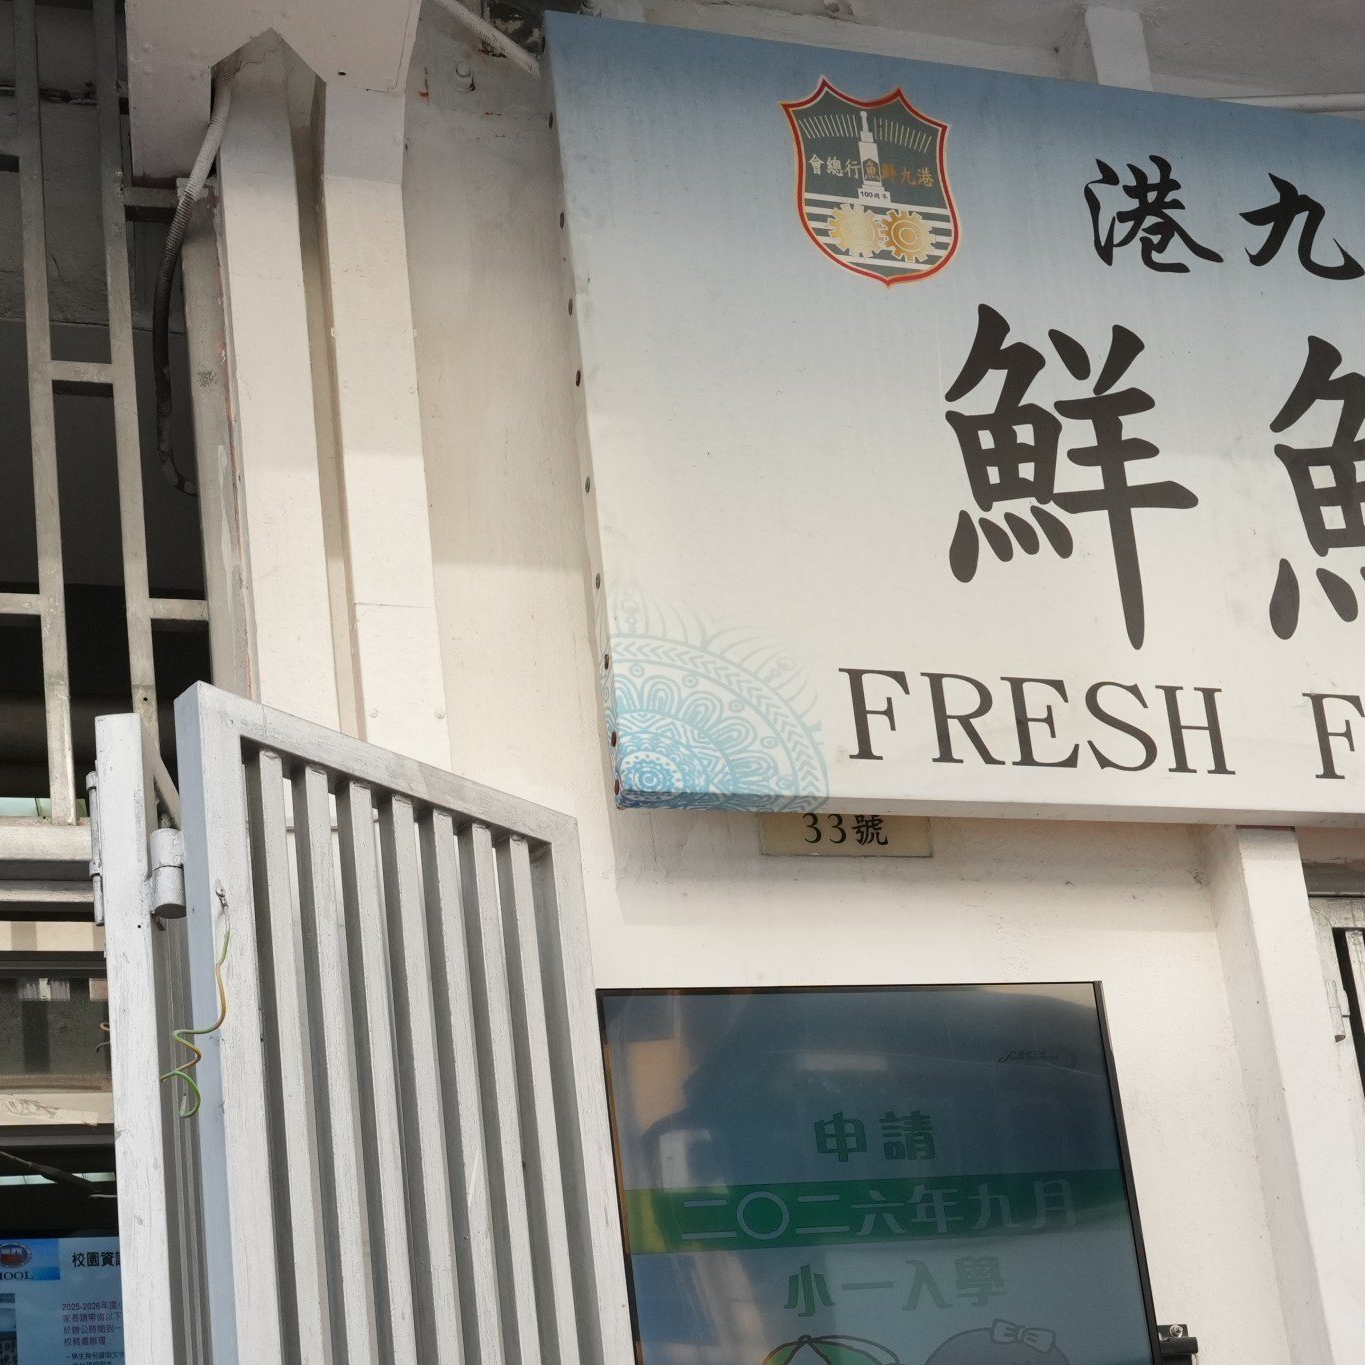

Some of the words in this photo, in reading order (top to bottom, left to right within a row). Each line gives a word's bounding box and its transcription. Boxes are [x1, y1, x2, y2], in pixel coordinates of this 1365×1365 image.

[838, 666, 1237, 776] FRESH
[813, 1108, 937, 1164] 申請
[783, 1255, 1007, 1318] 小一入學
